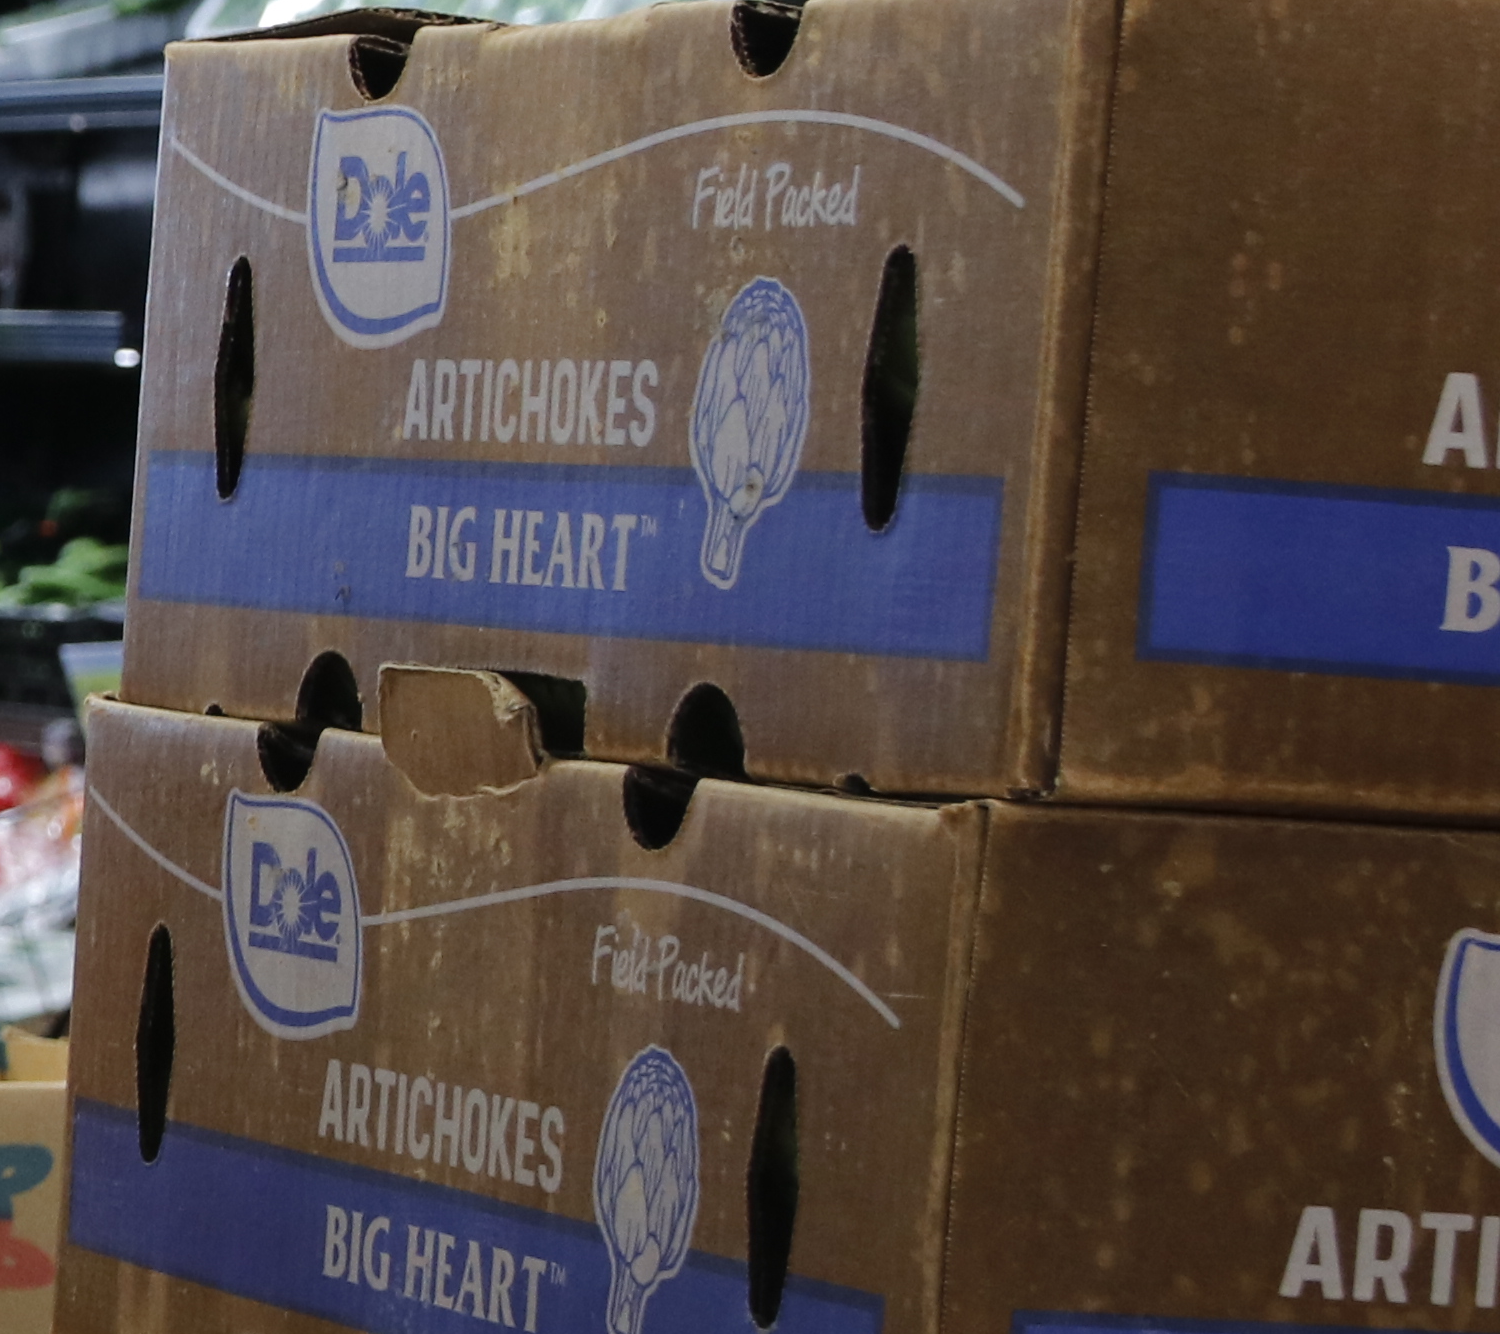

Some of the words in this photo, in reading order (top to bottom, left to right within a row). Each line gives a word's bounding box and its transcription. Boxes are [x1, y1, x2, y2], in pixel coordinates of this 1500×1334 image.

[334, 151, 432, 247] Dole
[690, 162, 759, 231] Field
[764, 161, 862, 232] Packed
[402, 357, 660, 448] ARTICHOKES
[1421, 370, 1500, 471] A
[404, 503, 478, 583] BIG
[250, 841, 343, 944] Dole
[591, 921, 649, 997] Field
[657, 933, 745, 1013] Packed
[317, 1057, 566, 1195] ARTICHOKES
[321, 1203, 392, 1292] BIG
